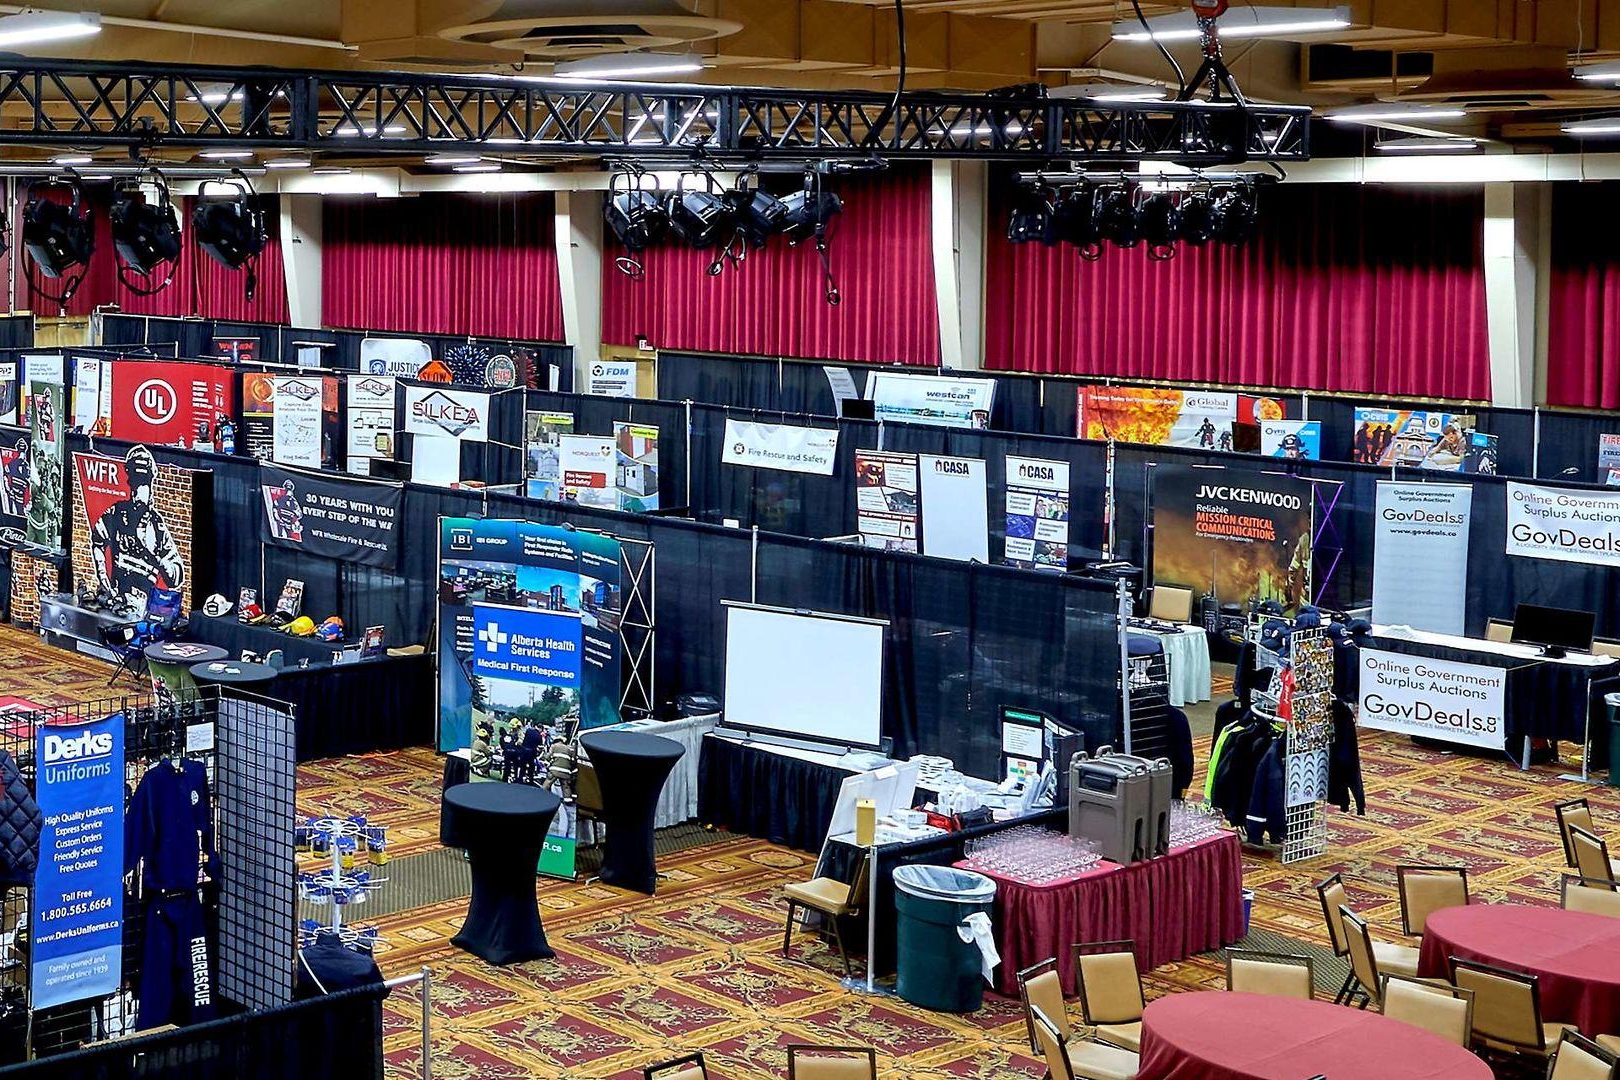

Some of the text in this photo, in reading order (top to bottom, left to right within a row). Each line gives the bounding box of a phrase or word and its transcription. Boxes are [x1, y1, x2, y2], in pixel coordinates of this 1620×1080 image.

[606, 367, 629, 376] FDM
[144, 388, 168, 416] UL
[926, 390, 970, 400] westcan
[1197, 396, 1229, 407] Global
[412, 402, 480, 424] SILKEA
[748, 448, 762, 457] Fire
[787, 452, 801, 461] and
[803, 454, 828, 465] Safety
[83, 459, 119, 486] WFR
[943, 460, 970, 475] CASA
[1027, 465, 1054, 480] CASA
[306, 494, 395, 517] 30 YEARS WITH YOU
[1513, 490, 1553, 505] Online
[303, 506, 378, 528] EVERY STEP OF THE
[1196, 503, 1229, 515] Reliable
[1524, 504, 1567, 519] Surplus
[1196, 512, 1274, 531] MISSION CRITICAL
[453, 535, 471, 544] IBI
[1196, 522, 1277, 541] COMMUNICATIONS
[511, 634, 543, 648] Alberta
[546, 638, 575, 652] Health
[511, 645, 551, 660] Services
[477, 658, 575, 679] Medical First Response
[1365, 657, 1500, 689] Online Government
[1377, 672, 1487, 700] Surplus Auctions
[1403, 718, 1433, 729] SERVICES
[44, 730, 113, 762] Derks
[45, 761, 111, 785] Uniforms
[44, 804, 114, 826] High Quality Uniforms
[55, 819, 103, 837] Express Service
[55, 832, 103, 849] Custom Orders
[54, 844, 103, 862] Friendly Service
[59, 860, 98, 874] Free Quotes
[62, 890, 93, 903] Toll Free
[41, 897, 112, 923] 1.800.565.6664
[36, 919, 119, 945] www.DerksUniforms.ca
[48, 953, 107, 974] Family owned and
[45, 964, 109, 987] operated since 1939
